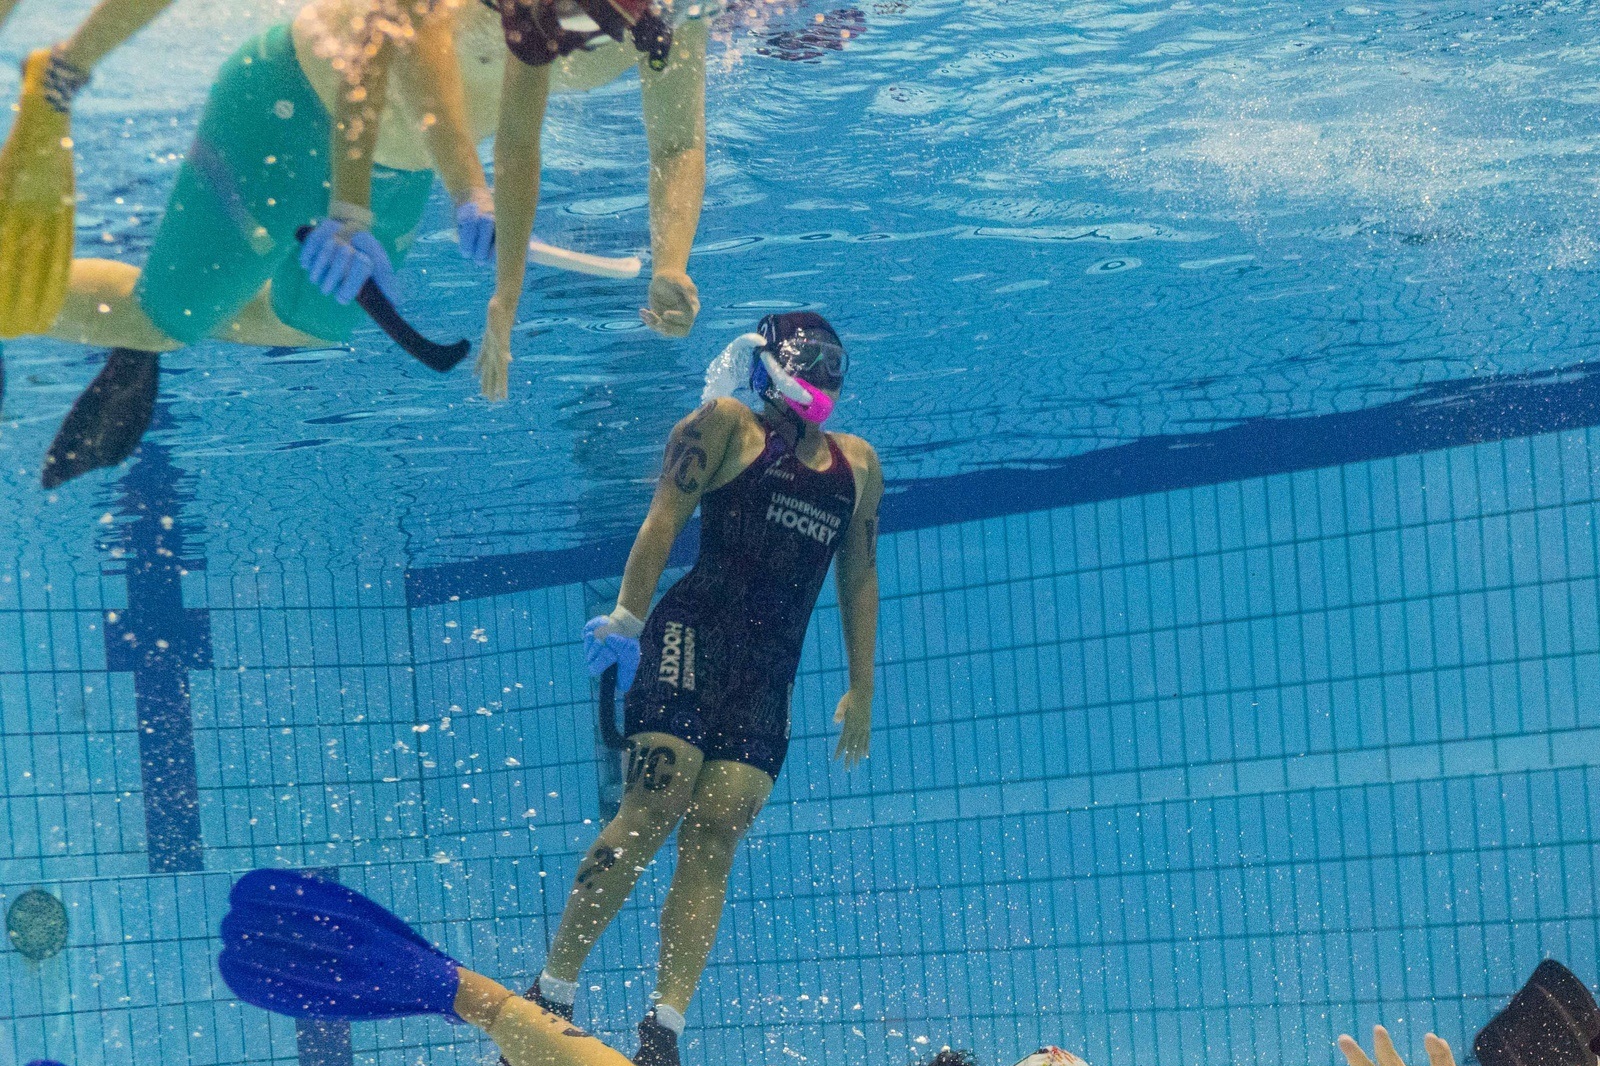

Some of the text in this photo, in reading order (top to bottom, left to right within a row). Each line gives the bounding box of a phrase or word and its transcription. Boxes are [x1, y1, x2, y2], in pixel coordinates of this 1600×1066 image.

[765, 503, 837, 546] HOCKEY
[771, 491, 842, 529] UNDERWATER
[658, 621, 683, 688] HOCKEY
